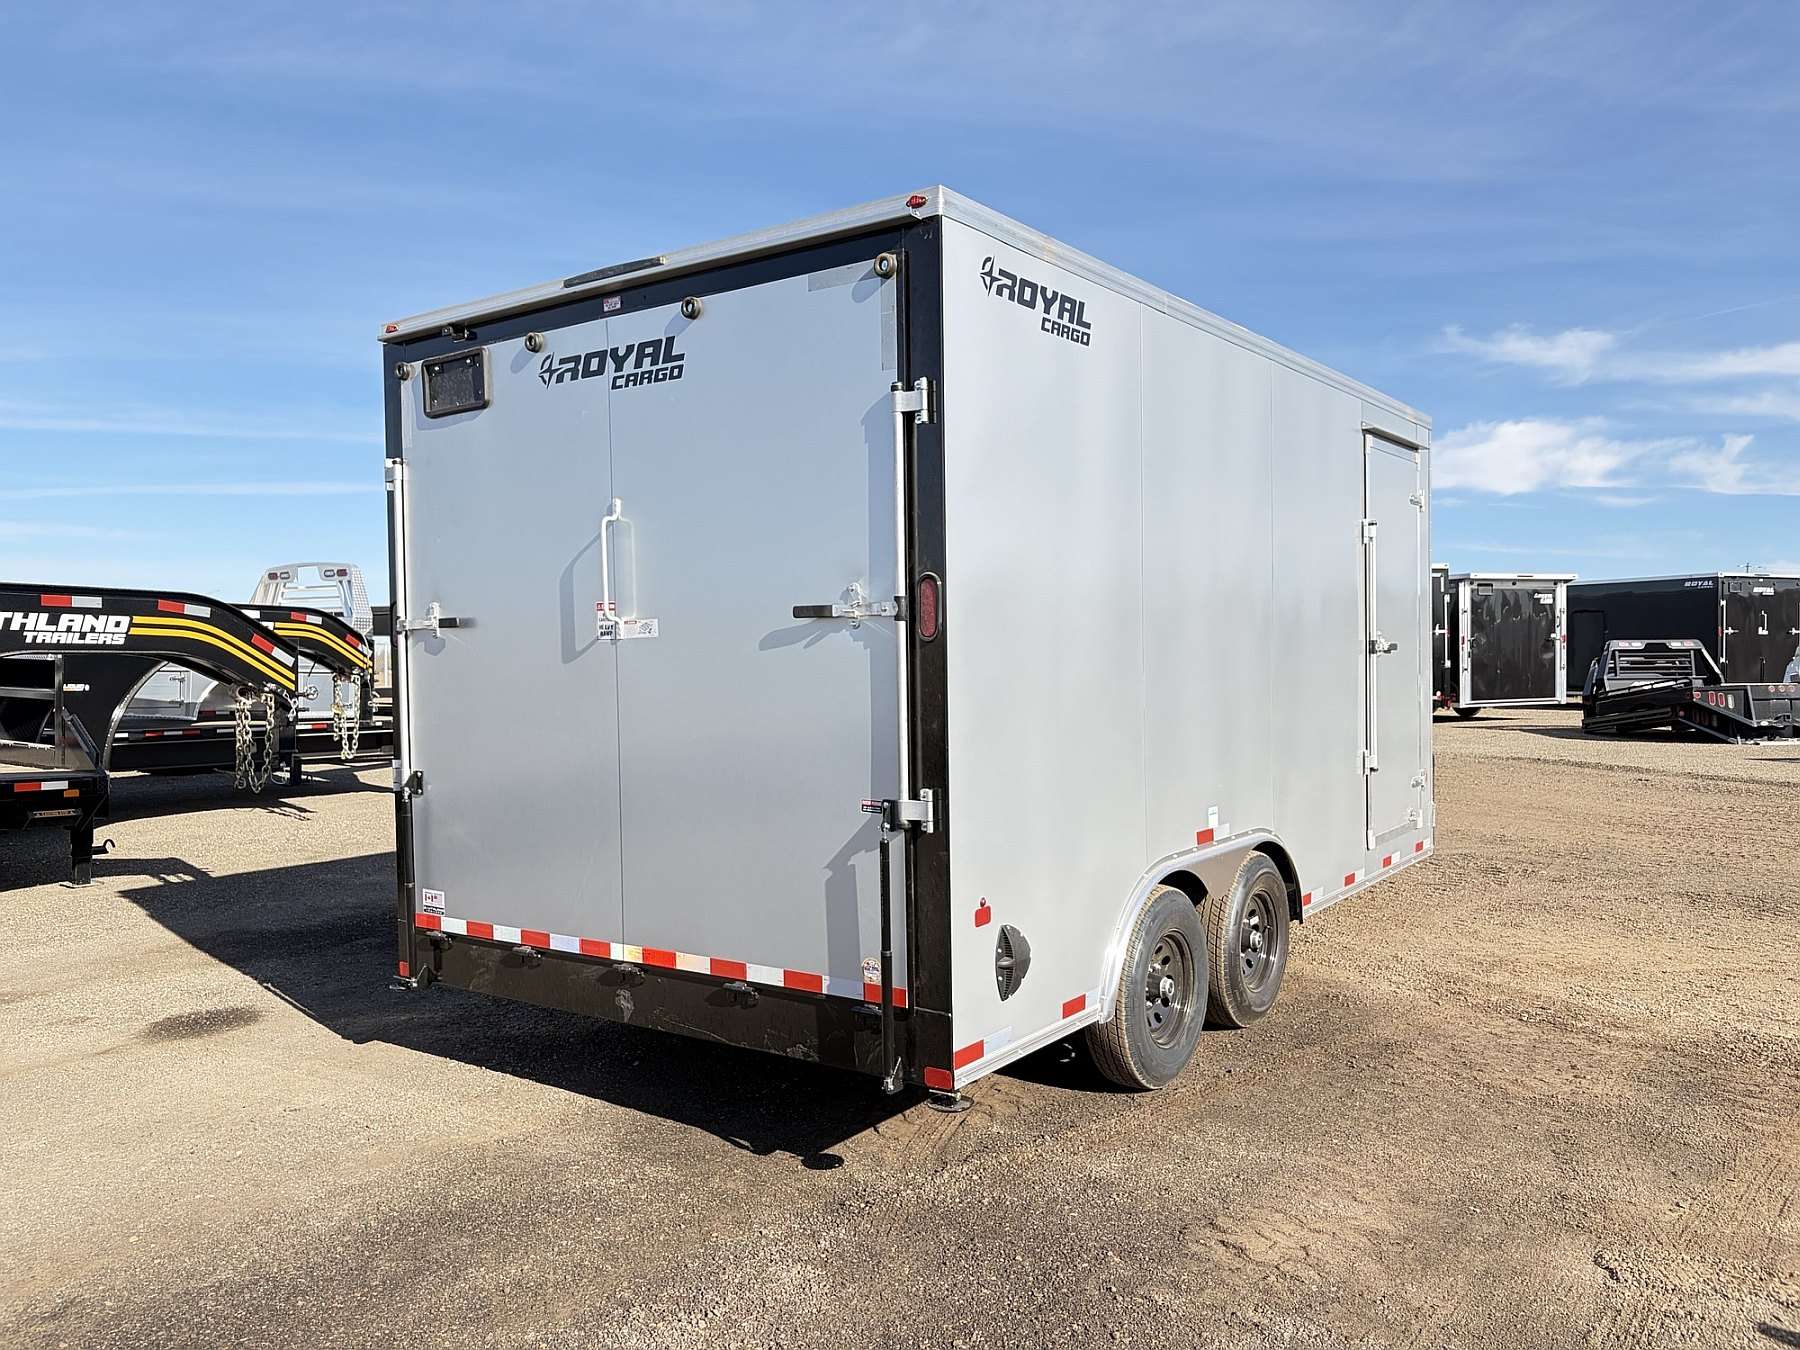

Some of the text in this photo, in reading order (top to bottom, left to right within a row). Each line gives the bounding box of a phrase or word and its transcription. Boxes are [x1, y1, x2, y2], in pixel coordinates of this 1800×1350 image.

[996, 267, 1092, 330] ROYAL
[1040, 316, 1091, 347] CARGO
[555, 335, 686, 385] ROYAL
[611, 364, 685, 391] CARGO
[23, 631, 127, 645] TRAILERS
